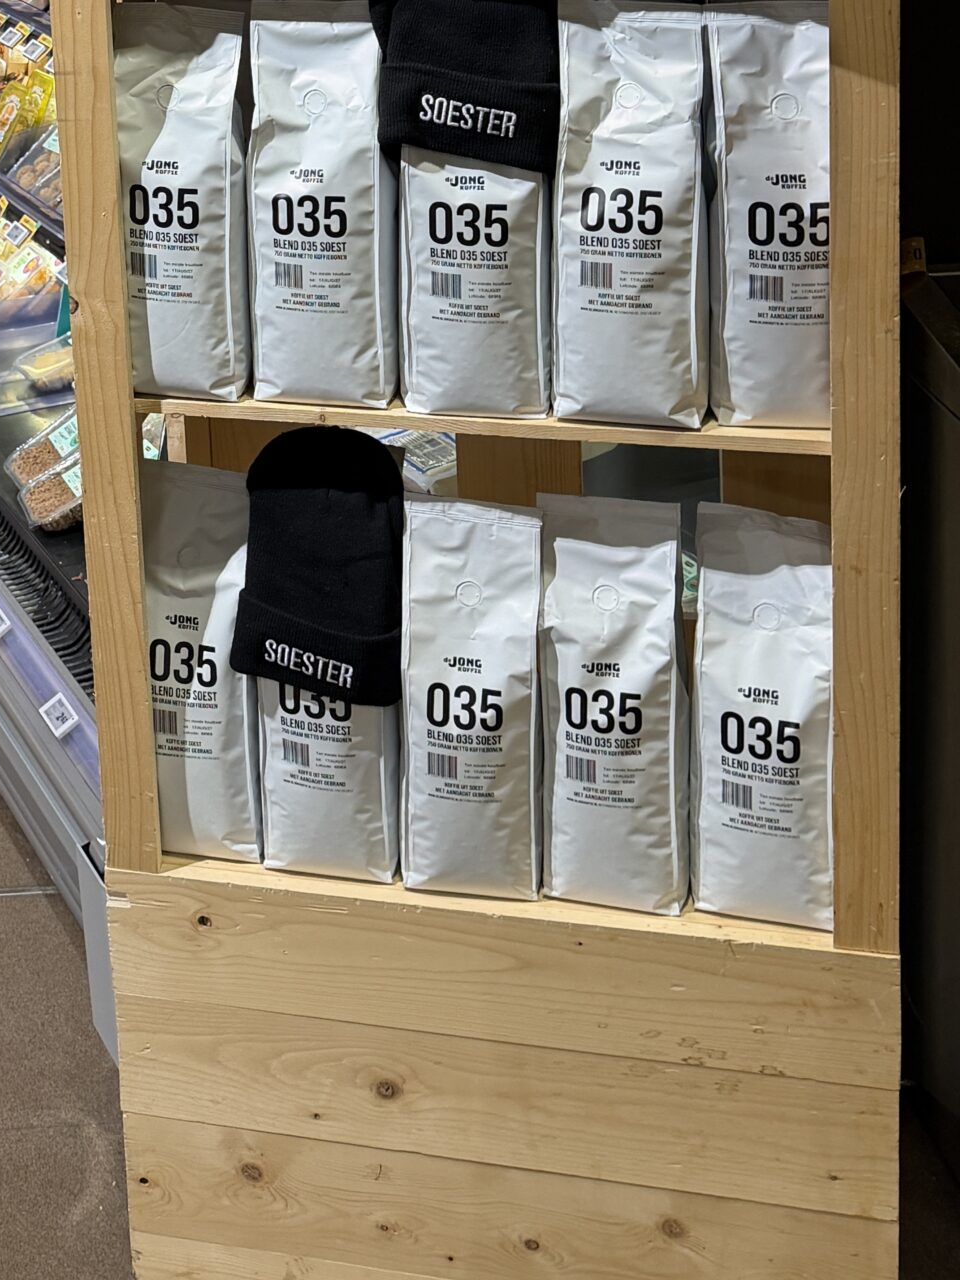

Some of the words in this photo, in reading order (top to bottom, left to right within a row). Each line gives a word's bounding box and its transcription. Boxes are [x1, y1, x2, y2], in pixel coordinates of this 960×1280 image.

[419, 94, 517, 139] SOESTER
[129, 184, 200, 230] 035
[271, 193, 348, 238] 035
[580, 186, 664, 236] 035
[129, 228, 154, 242] BLEND
[155, 231, 171, 243] 035
[173, 232, 199, 244] SOEST
[428, 201, 509, 248] 035
[273, 238, 299, 251] BLEND
[300, 240, 318, 251] 035
[319, 241, 347, 253] SOEST
[430, 247, 458, 260] BLEND
[459, 249, 478, 261] 035
[480, 250, 509, 262] SOEST
[579, 235, 609, 248] BLEND
[611, 237, 630, 250] 035
[632, 238, 662, 251] SOEST
[748, 249, 780, 261] BLEND
[782, 251, 802, 262] 035
[804, 250, 830, 262] SOES
[149, 638, 218, 688] 035
[264, 638, 354, 688] SOESTER
[175, 688, 191, 700] 035
[192, 690, 217, 702] SOEST
[426, 682, 504, 732] 035
[565, 687, 643, 735] 035
[280, 716, 306, 731] BLEND
[307, 721, 324, 734] 035
[325, 724, 352, 737] SOEST
[427, 728, 454, 743] BLEND
[456, 733, 474, 745] 035
[475, 734, 503, 746] SOEST
[565, 730, 592, 746] BLEND
[594, 737, 612, 749] 035
[614, 737, 642, 749] SOEST
[720, 711, 801, 764] 035
[721, 755, 749, 771] BLEND
[751, 762, 769, 776] 035
[771, 766, 800, 779] SOEST
